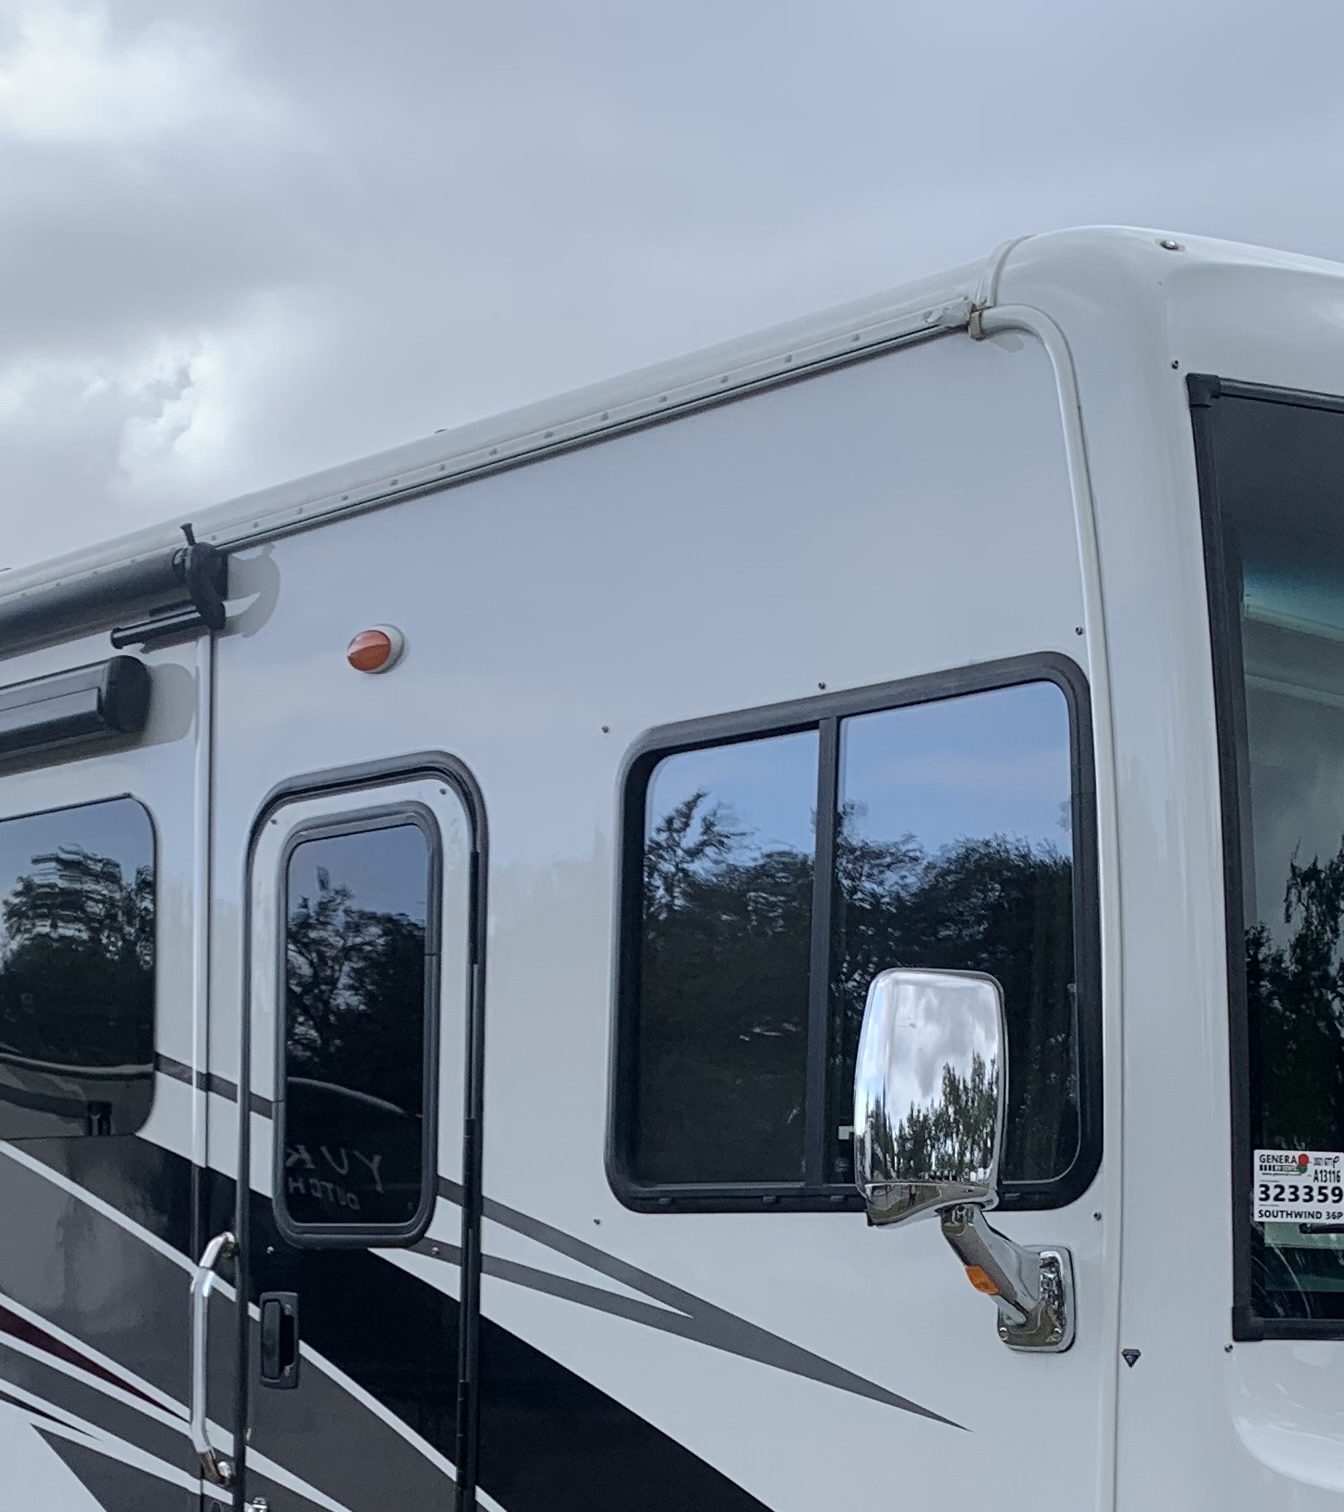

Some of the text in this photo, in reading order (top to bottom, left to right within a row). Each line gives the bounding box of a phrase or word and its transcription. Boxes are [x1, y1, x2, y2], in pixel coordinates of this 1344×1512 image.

[1259, 1154, 1298, 1164] GENERA
[1258, 1184, 1344, 1204] 323359
[1258, 1209, 1344, 1220] SOUTHWIND 36P
